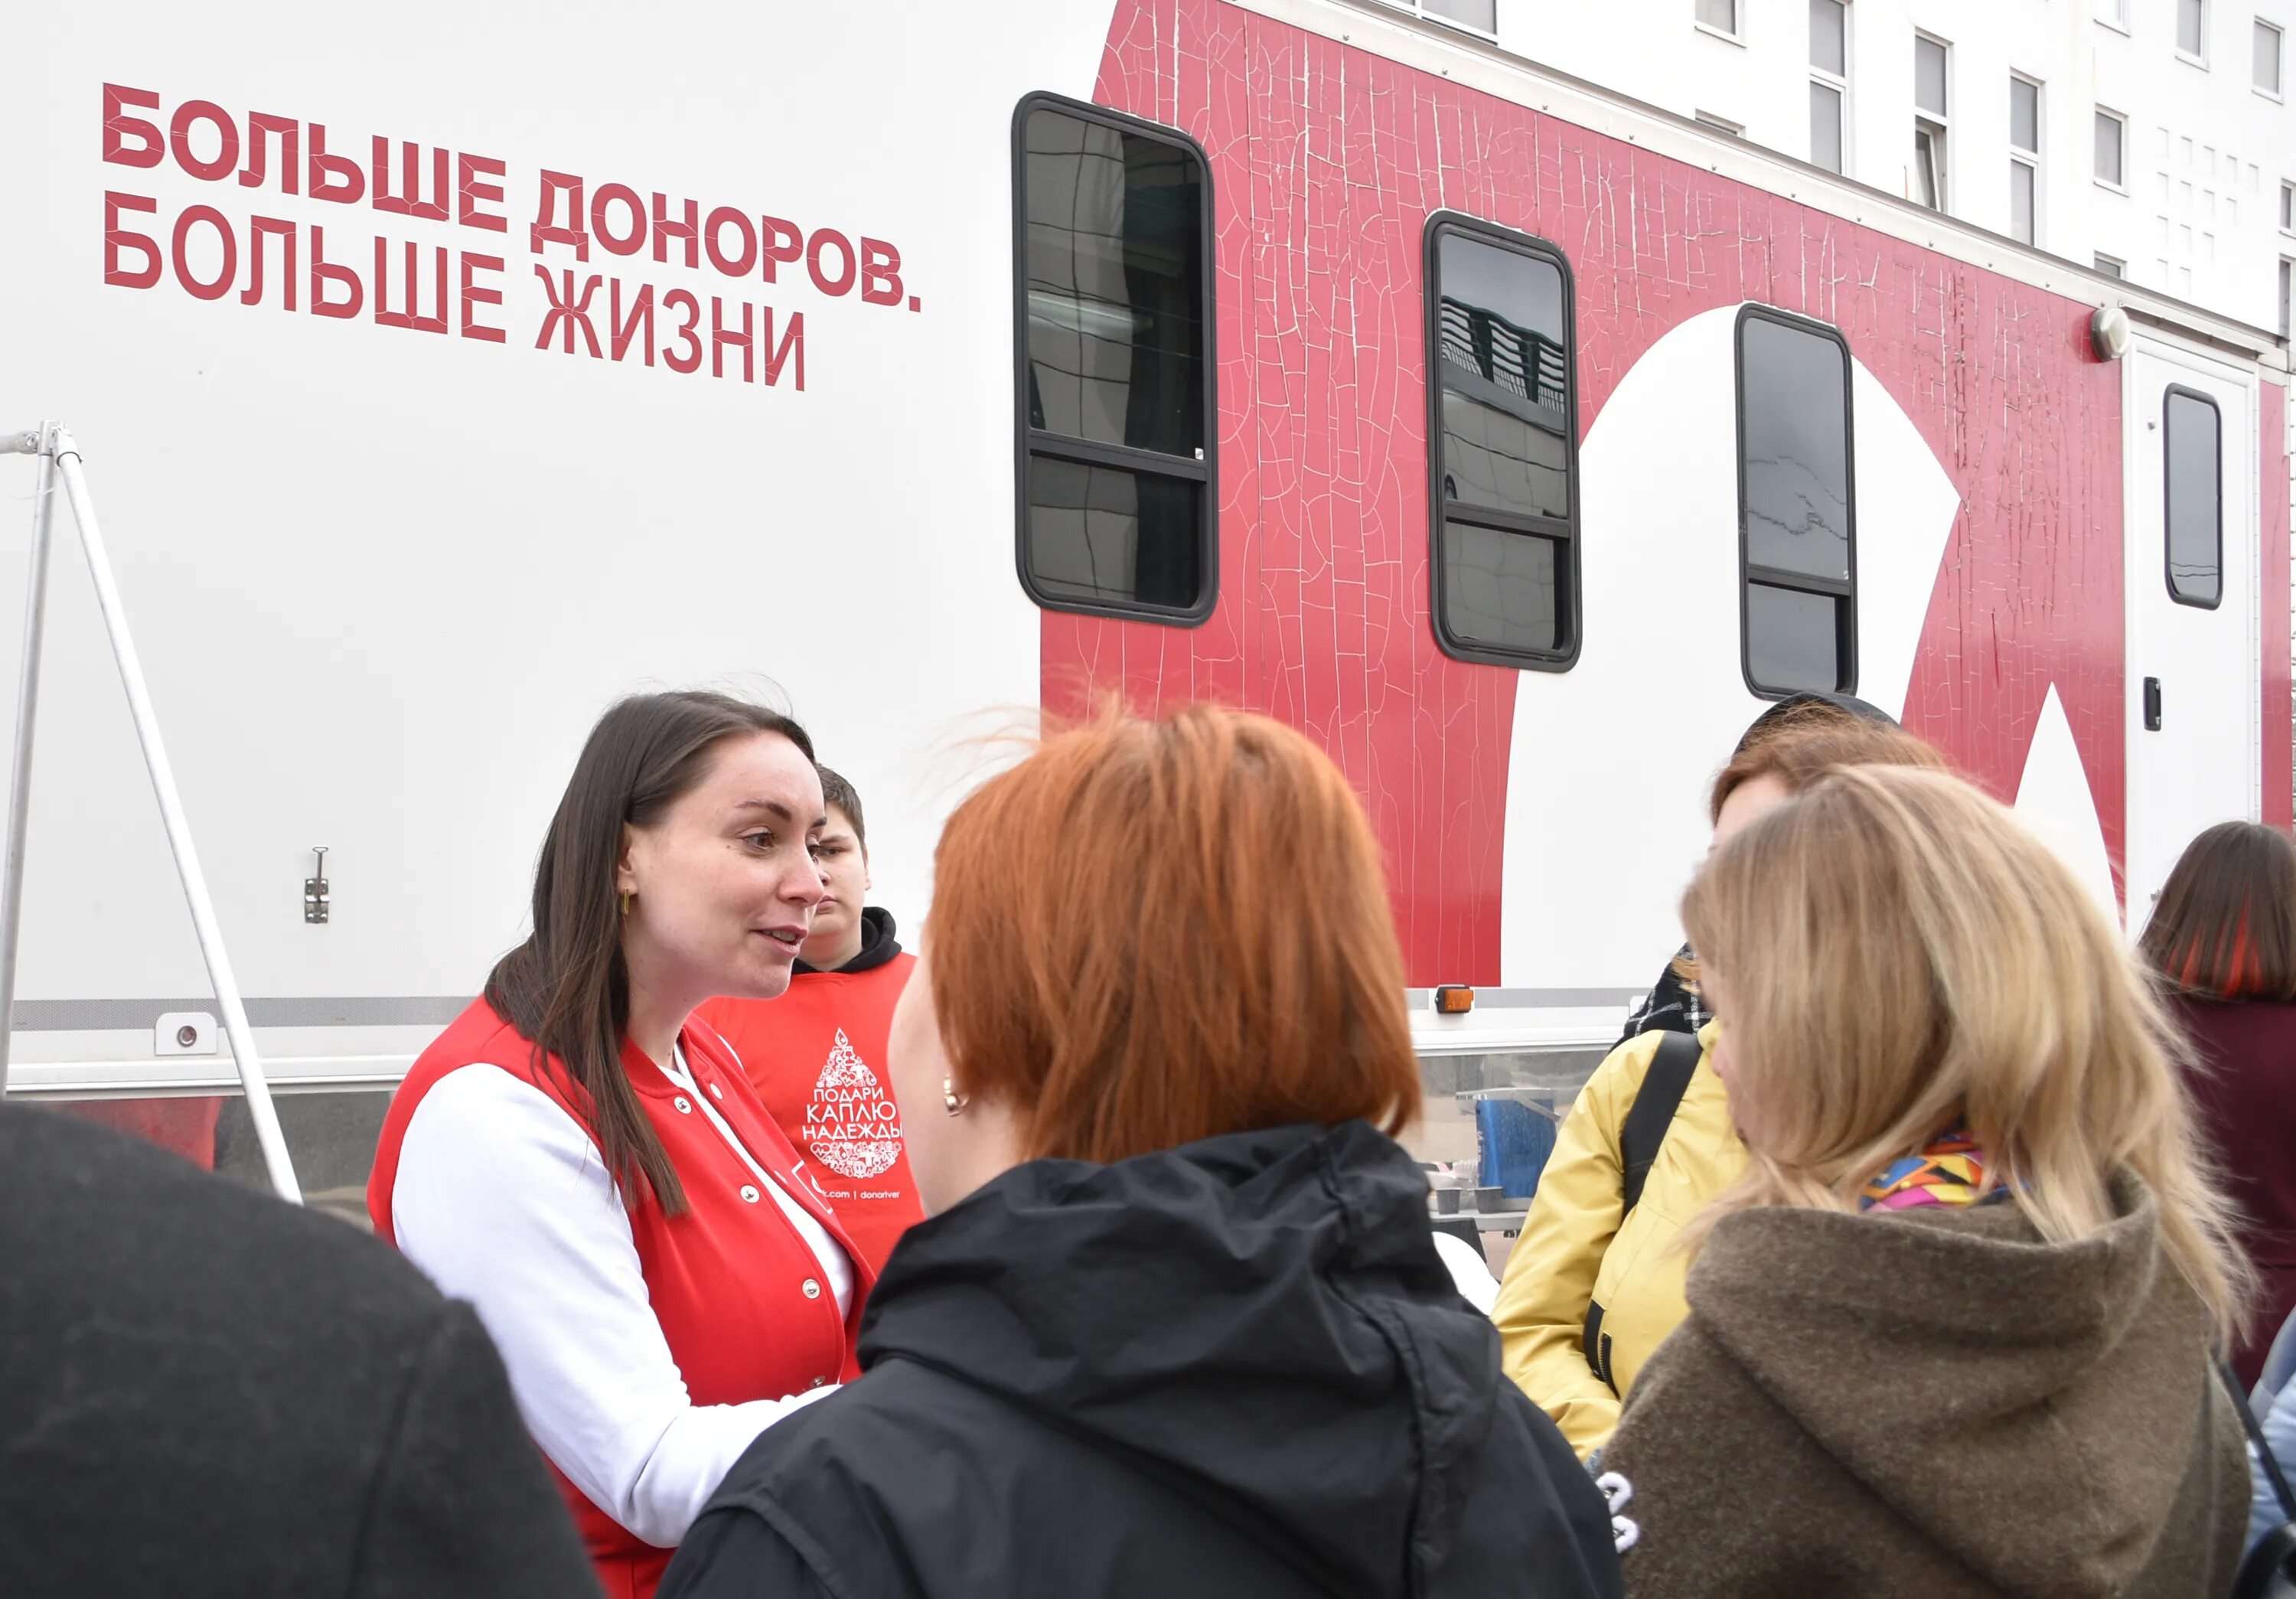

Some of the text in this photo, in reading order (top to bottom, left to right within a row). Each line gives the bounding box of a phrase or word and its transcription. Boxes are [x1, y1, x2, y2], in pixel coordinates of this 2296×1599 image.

[103, 83, 921, 313] БОЛЬШЕ ДОНОРОВ.
[104, 191, 805, 392] БОЛЬШЕ ЖИЗНИ
[814, 1086, 884, 1103] ПОДАРИ
[806, 1101, 896, 1124] КАПЛЮ
[802, 1121, 903, 1141] НАДЕЖДЫ
